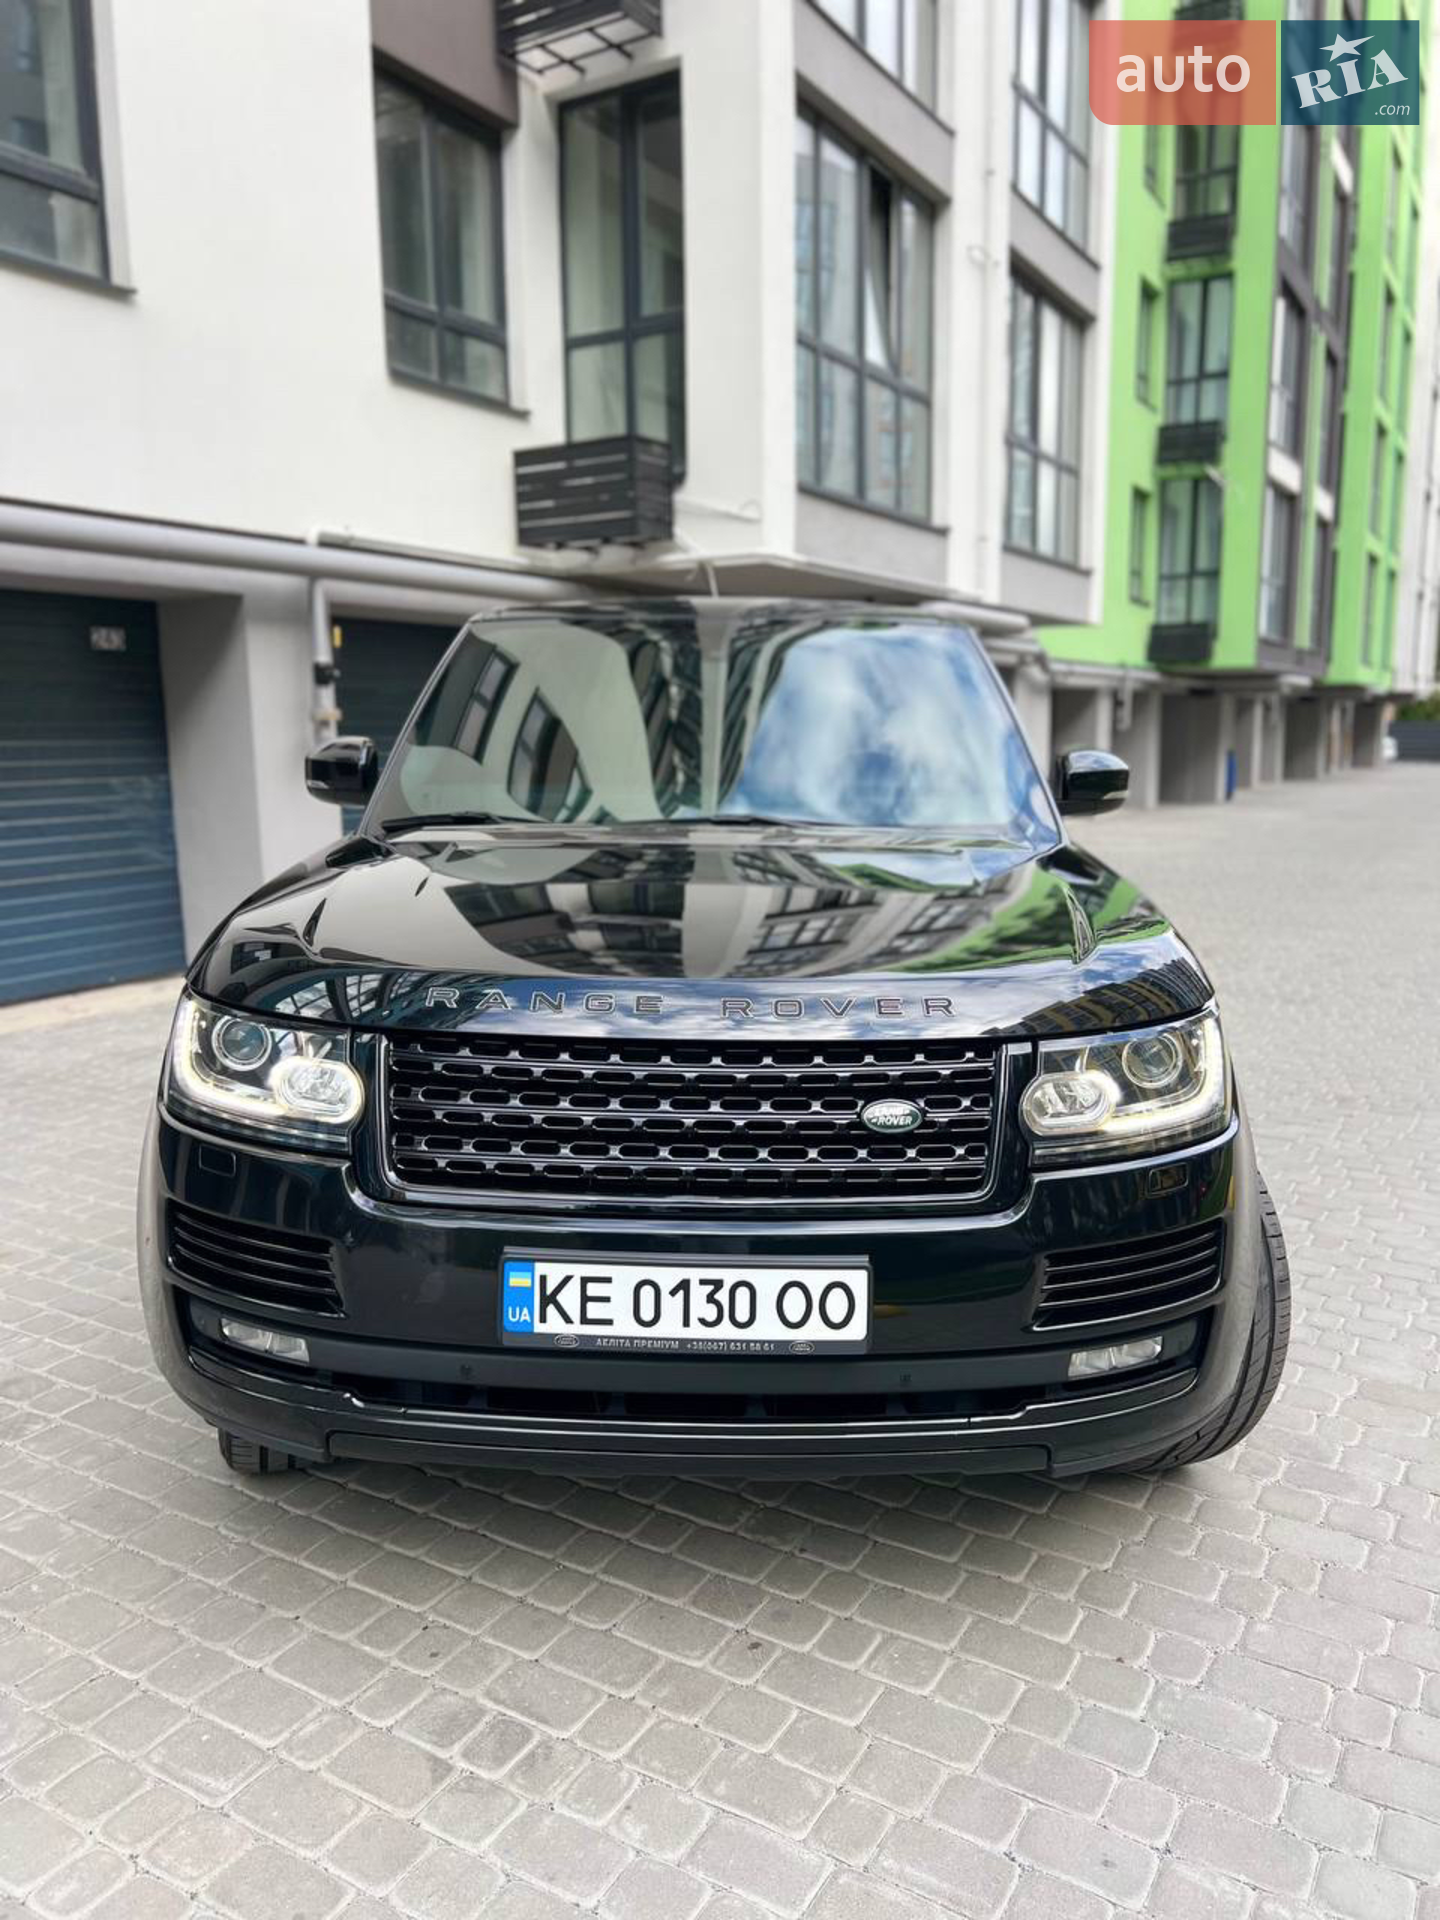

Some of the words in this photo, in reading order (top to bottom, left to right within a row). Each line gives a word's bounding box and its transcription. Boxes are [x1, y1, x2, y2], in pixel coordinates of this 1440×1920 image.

[425, 987, 664, 1014] RANGE
[719, 996, 956, 1019] ROVER
[877, 1115, 913, 1126] ROVER
[538, 1274, 614, 1327] KE
[632, 1278, 757, 1328] 0130
[775, 1280, 856, 1330] OO
[508, 1306, 532, 1324] UA
